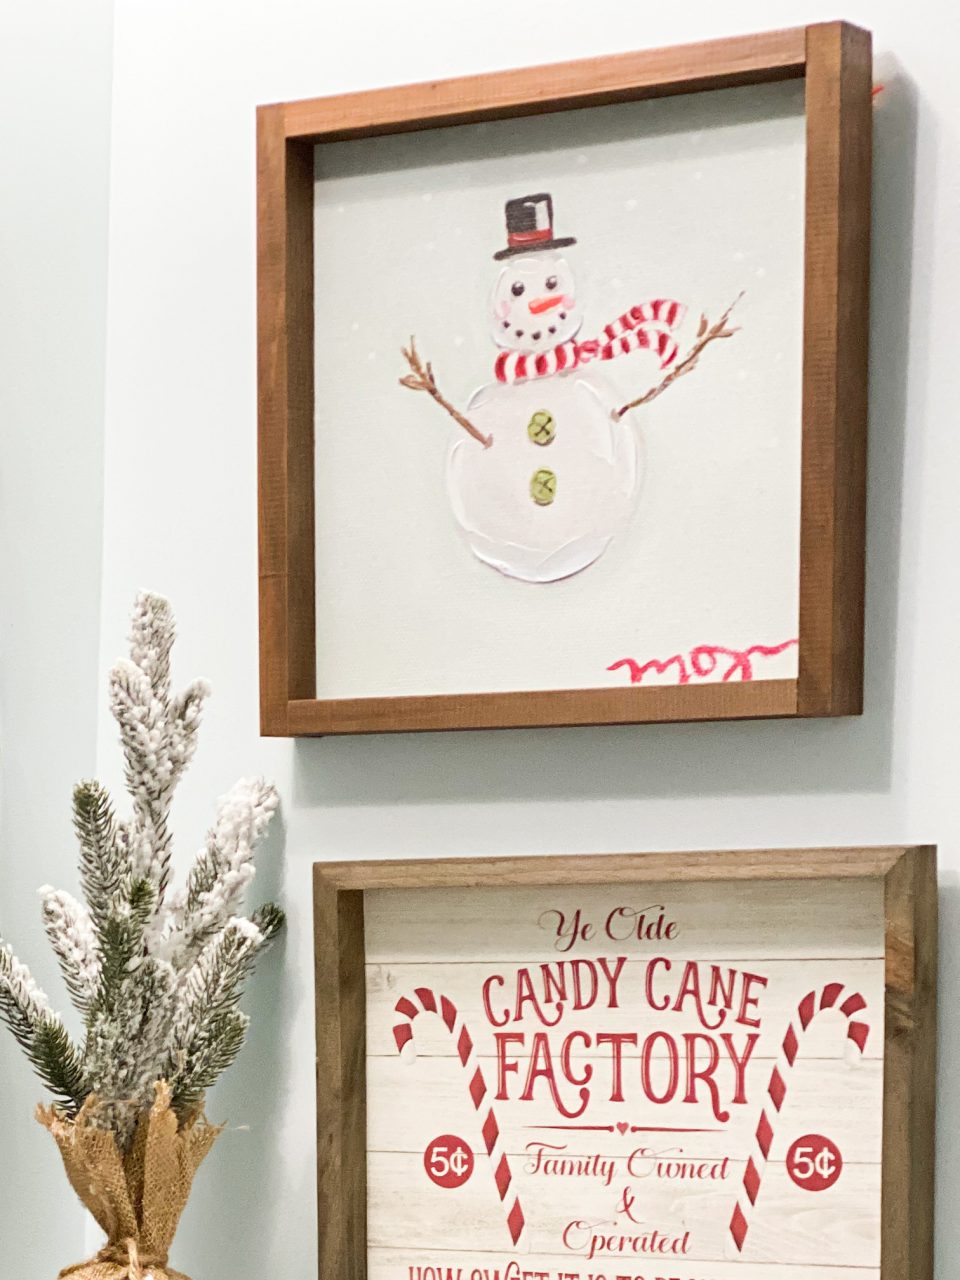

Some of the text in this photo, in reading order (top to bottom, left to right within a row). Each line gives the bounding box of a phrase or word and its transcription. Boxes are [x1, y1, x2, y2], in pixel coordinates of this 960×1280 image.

[538, 905, 680, 952] Ye Olde
[482, 957, 768, 1030] CANDY CANE
[493, 1031, 761, 1122] FACTORY
[430, 1146, 469, 1177] 5¢
[523, 1142, 729, 1186] Family Owned
[793, 1146, 836, 1179] 5¢
[615, 1185, 643, 1224] &
[562, 1220, 691, 1260] Operated
